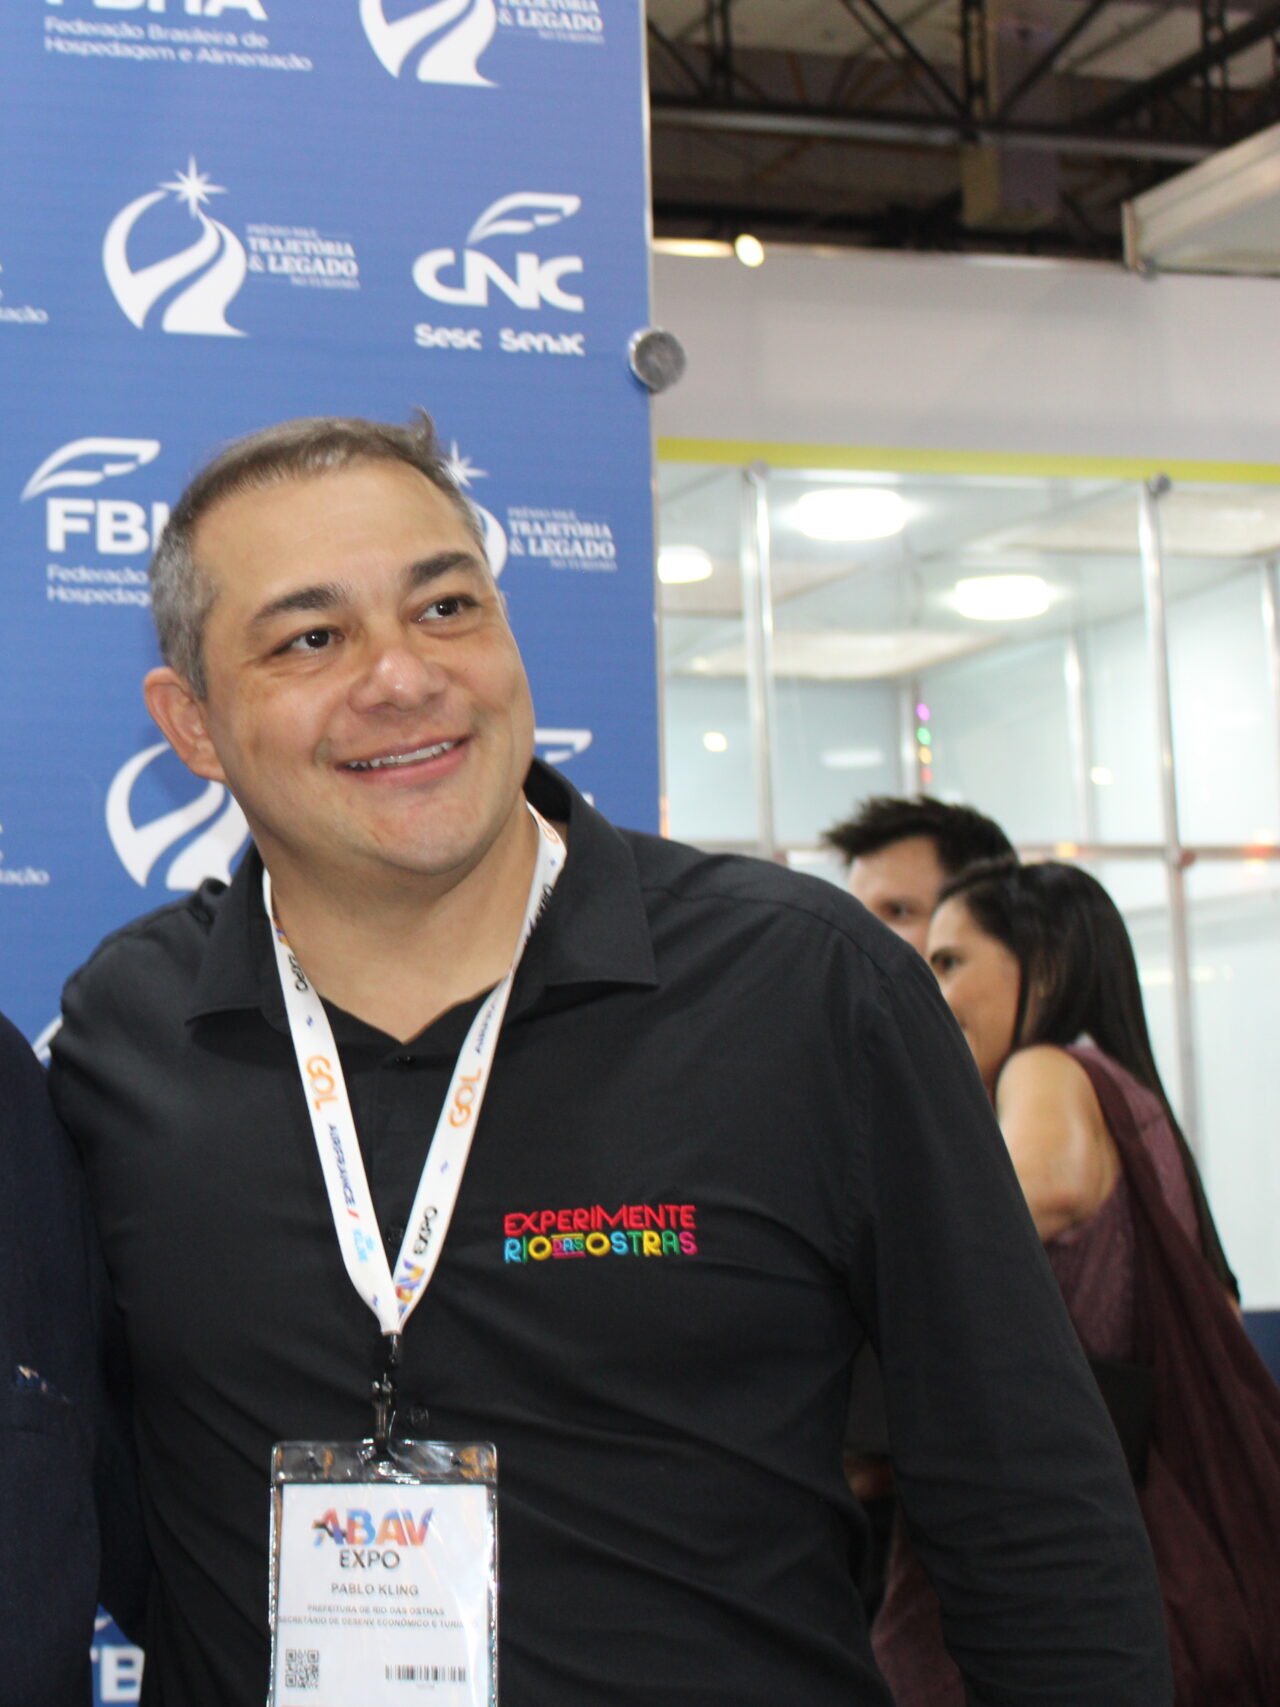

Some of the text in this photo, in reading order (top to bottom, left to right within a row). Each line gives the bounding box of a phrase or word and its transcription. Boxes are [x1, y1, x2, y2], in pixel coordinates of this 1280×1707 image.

[44, 16, 268, 48] Federação Brasileira de
[516, 9, 604, 32] LEGADO
[44, 37, 312, 71] Hospedagem e Alimentação
[248, 253, 358, 277] & LEGADO
[412, 248, 584, 312] CNC
[415, 323, 585, 356] Sesc Senac
[47, 498, 170, 554] FB
[510, 537, 616, 560] & LEGADO
[306, 1055, 338, 1111] GOL
[449, 1067, 482, 1128] GOL
[414, 1206, 438, 1255] EXPO
[504, 1204, 696, 1237] EXPERIMENTE
[504, 1230, 698, 1264] RIO DAS OSTRAS
[312, 1507, 434, 1548] ABAV
[340, 1549, 400, 1569] EXPO
[331, 1583, 419, 1596] PABLO KLING
